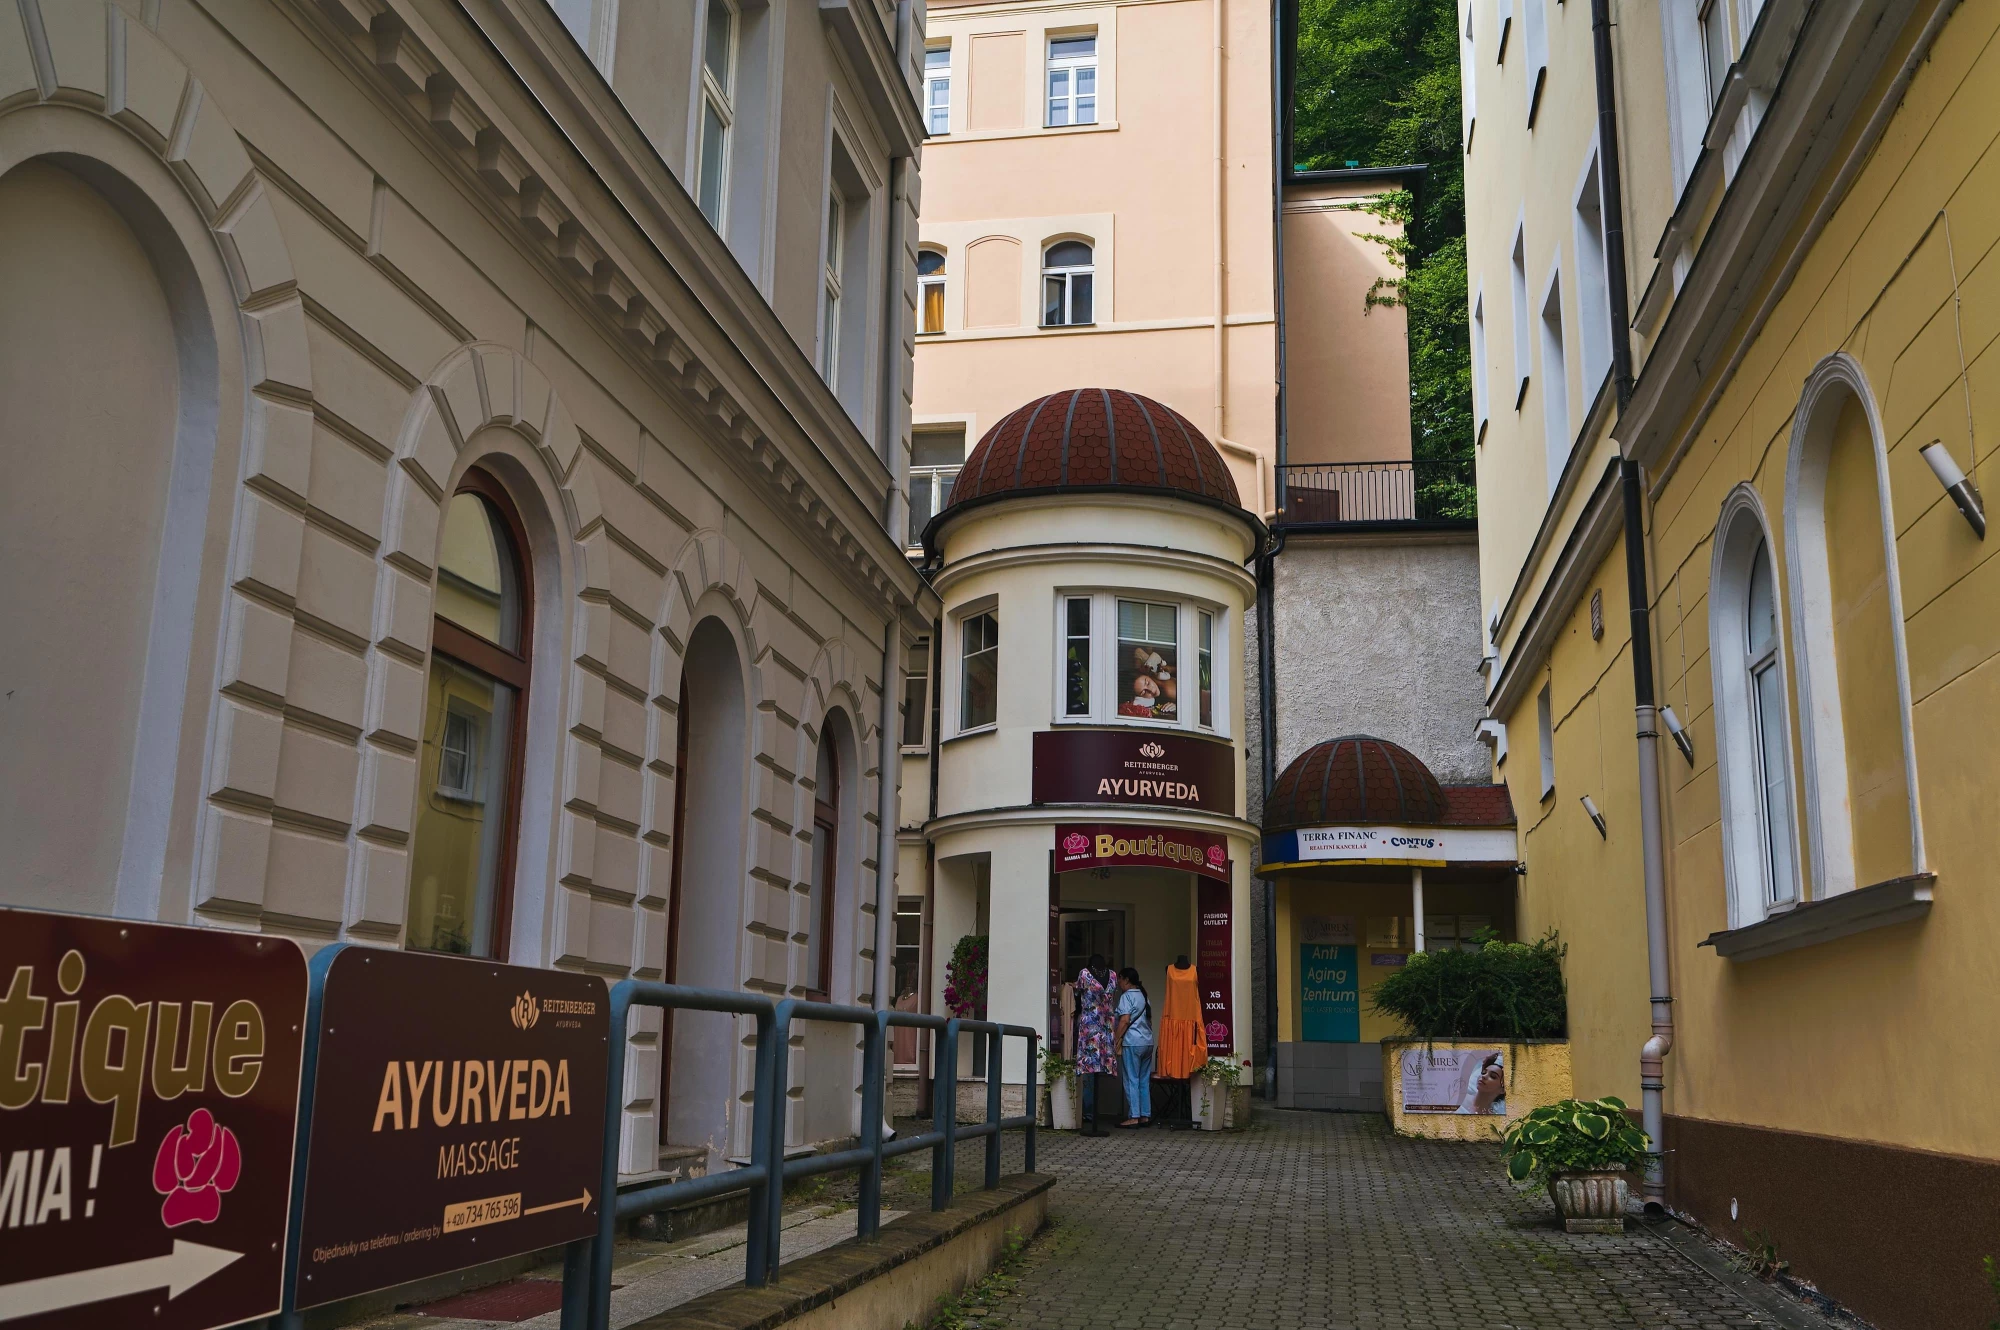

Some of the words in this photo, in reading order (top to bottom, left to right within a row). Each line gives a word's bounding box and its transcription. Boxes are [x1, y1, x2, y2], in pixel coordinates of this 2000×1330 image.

[1124, 761, 1179, 772] REITENBERGER
[1097, 778, 1200, 802] AYURVEDA
[1302, 832, 1335, 842] TERRA
[1338, 831, 1378, 841] FINANC
[1390, 837, 1435, 849] CONTUS
[1095, 834, 1204, 866] Boutique
[1320, 923, 1350, 933] MIREN
[1312, 946, 1339, 960] Anti
[1308, 967, 1347, 984] Aging
[1209, 991, 1221, 999] XS
[1303, 987, 1356, 1002] Zentrum
[542, 999, 596, 1015] REITENBERGER
[555, 1020, 582, 1029] AYURVEDA
[1427, 1057, 1459, 1067] MIREN
[372, 1059, 571, 1133] AYURVEDA
[437, 1137, 521, 1180] MASSAGE
[312, 1241, 359, 1262] Objednávky
[359, 1240, 369, 1251] na
[370, 1231, 398, 1251] telefonu
[403, 1228, 432, 1243] ordering
[432, 1223, 441, 1239] by
[466, 1205, 483, 1224] 734
[485, 1201, 501, 1221] 765
[503, 1197, 519, 1216] 596
